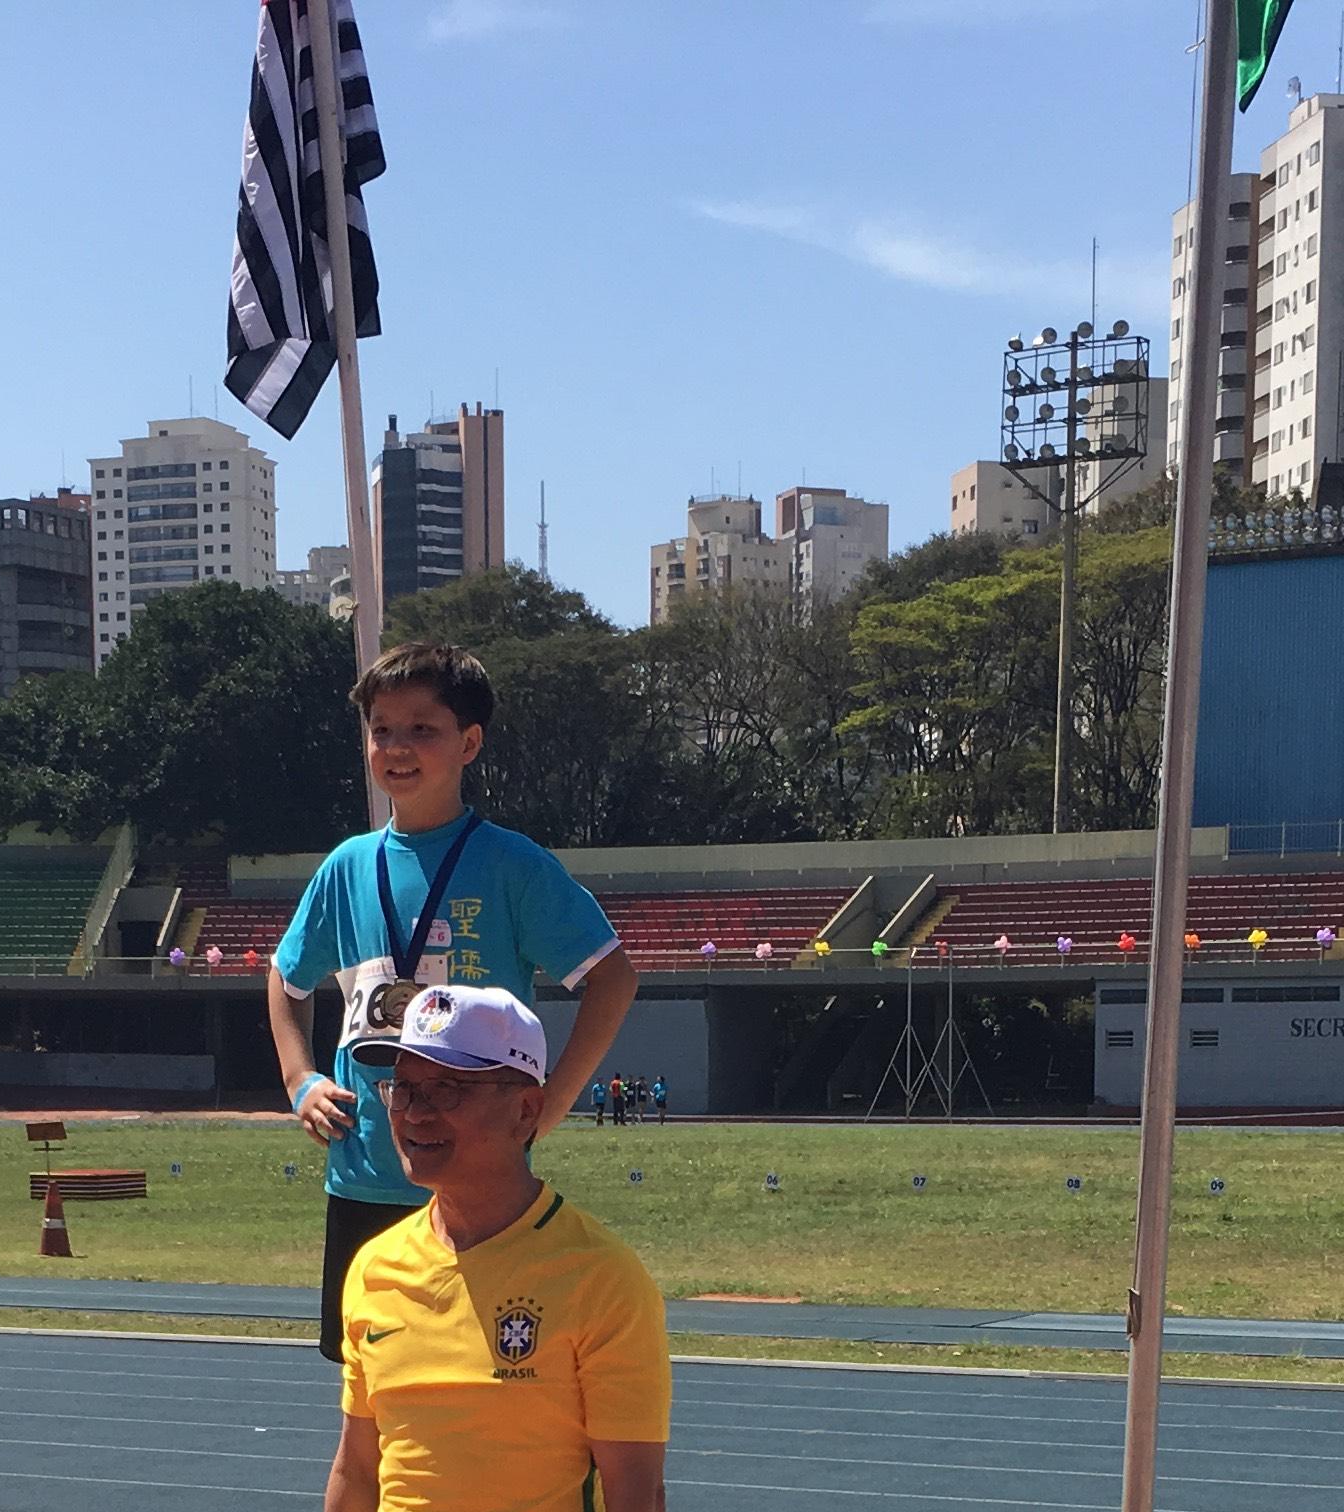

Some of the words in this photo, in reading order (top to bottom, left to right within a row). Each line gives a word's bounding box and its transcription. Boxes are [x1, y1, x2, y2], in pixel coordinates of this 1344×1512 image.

[630, 1172, 643, 1182] 05
[766, 1175, 778, 1185] 06
[913, 1176, 926, 1187] 07
[1067, 1178, 1080, 1189] 08
[1210, 1180, 1224, 1190] 09
[492, 1367, 538, 1379] BRASIL
